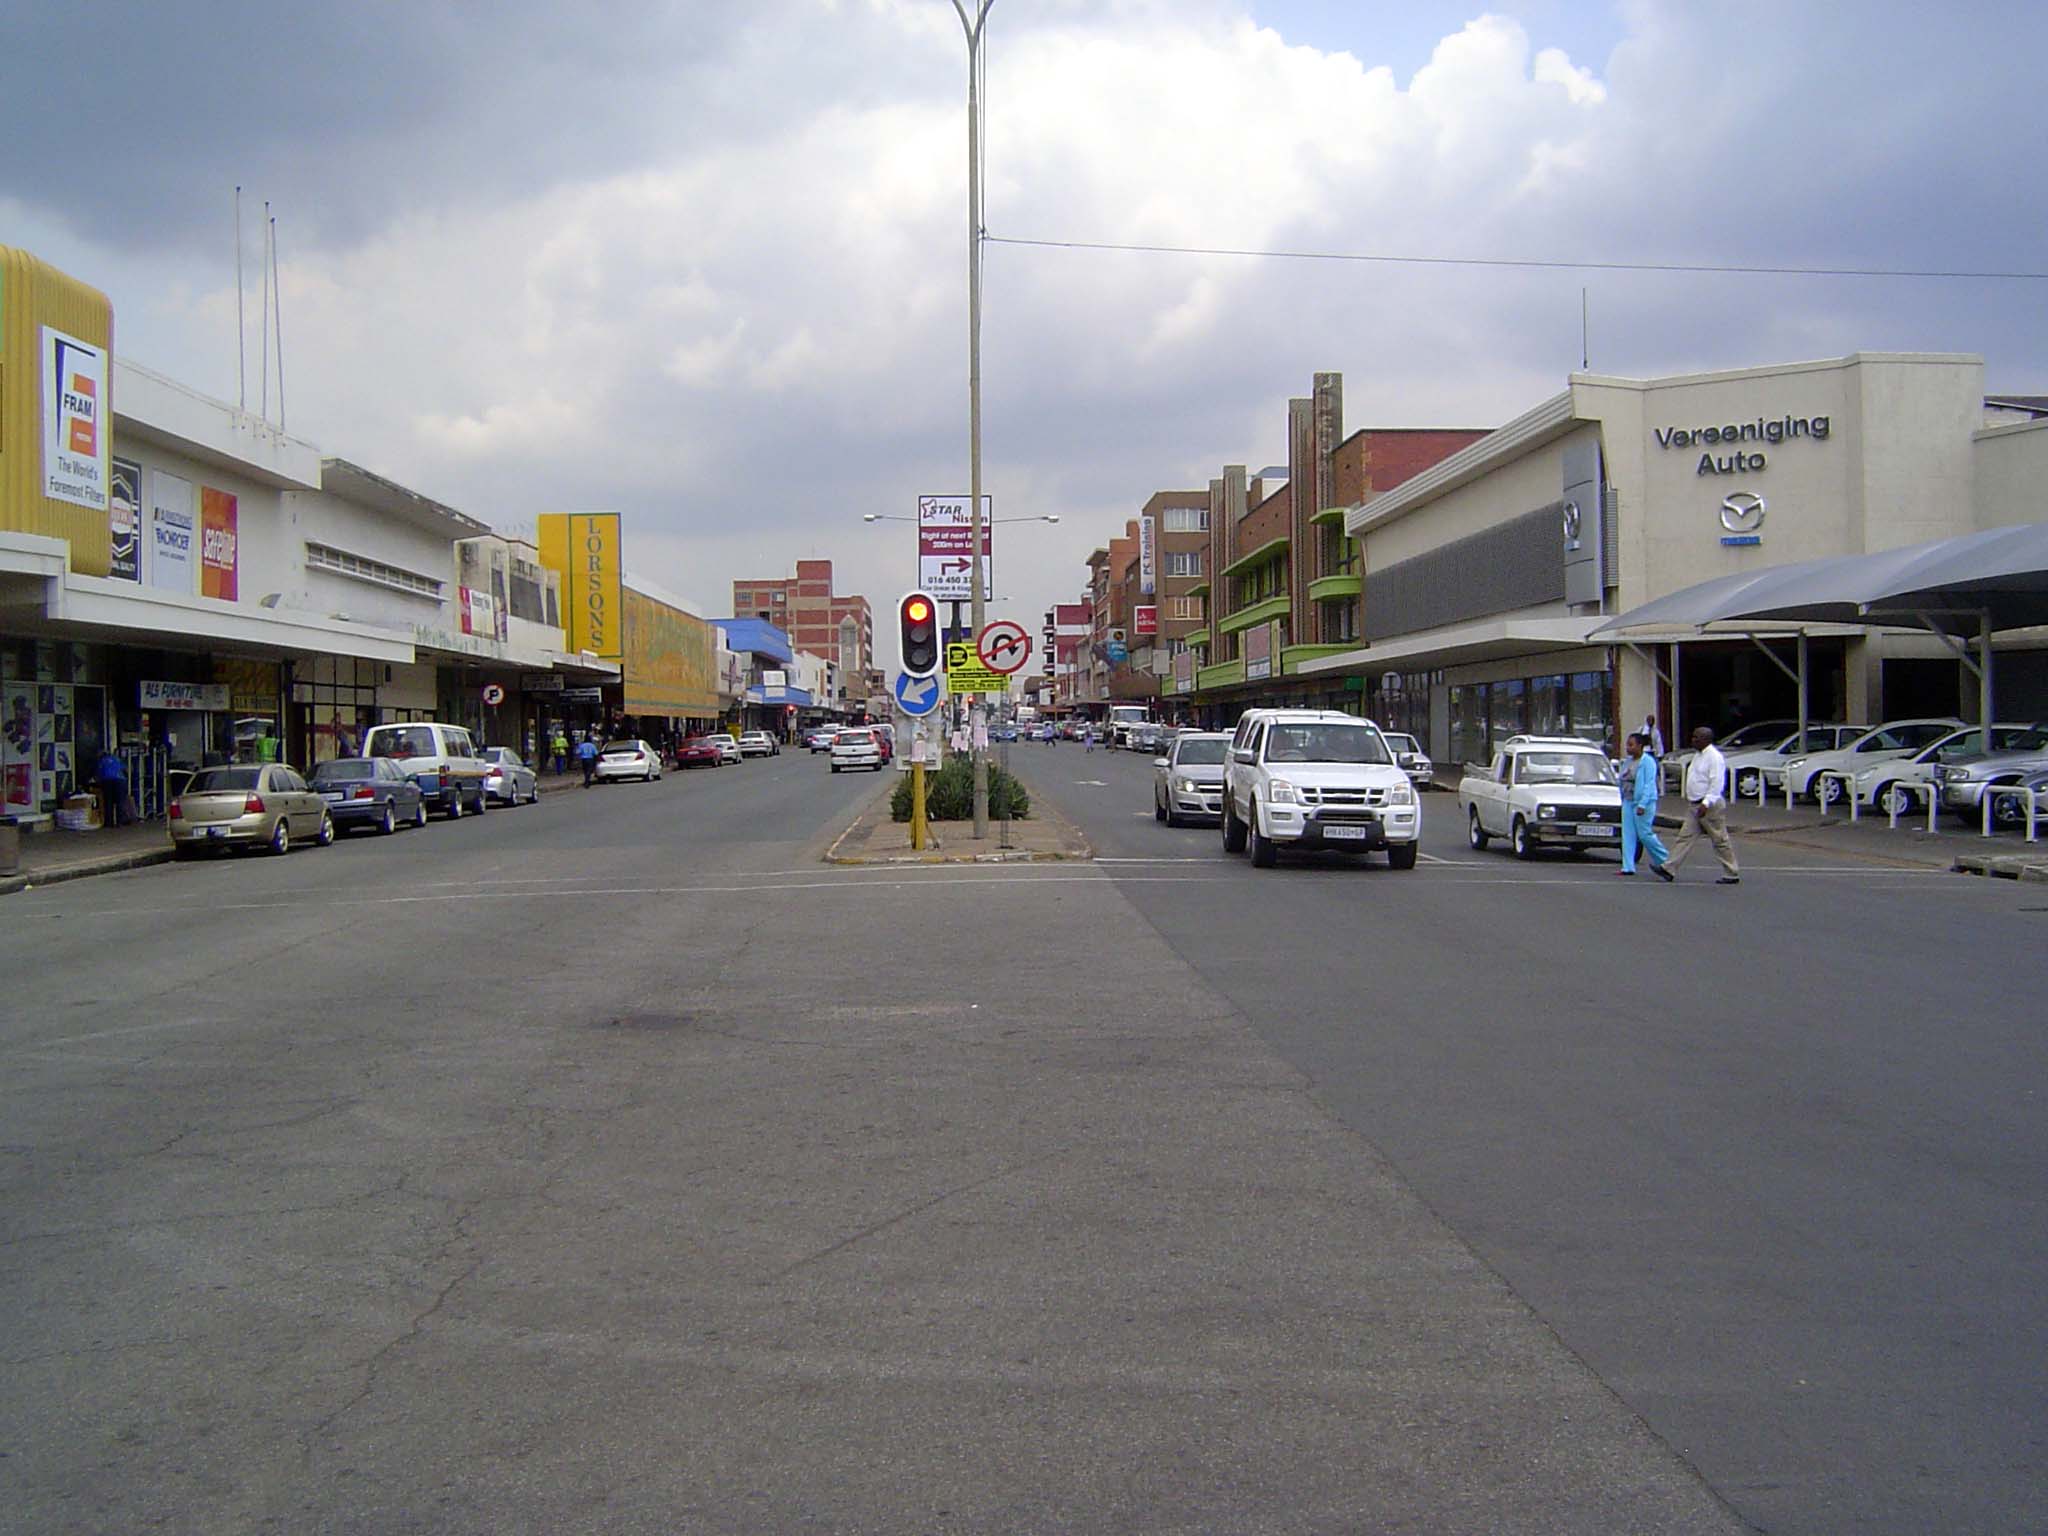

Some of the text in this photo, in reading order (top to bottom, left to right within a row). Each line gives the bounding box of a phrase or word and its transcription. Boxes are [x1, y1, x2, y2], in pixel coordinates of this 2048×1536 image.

[63, 393, 93, 417] FRAM
[1654, 414, 1831, 450] Vereeniging
[57, 455, 72, 473] The
[1697, 450, 1767, 477] Auto
[49, 476, 105, 505] Foremost Filters
[928, 504, 962, 515] STAR
[1142, 518, 1151, 560] Training
[586, 517, 605, 649] LORSONS
[928, 576, 944, 584] 016
[945, 576, 961, 584] 450
